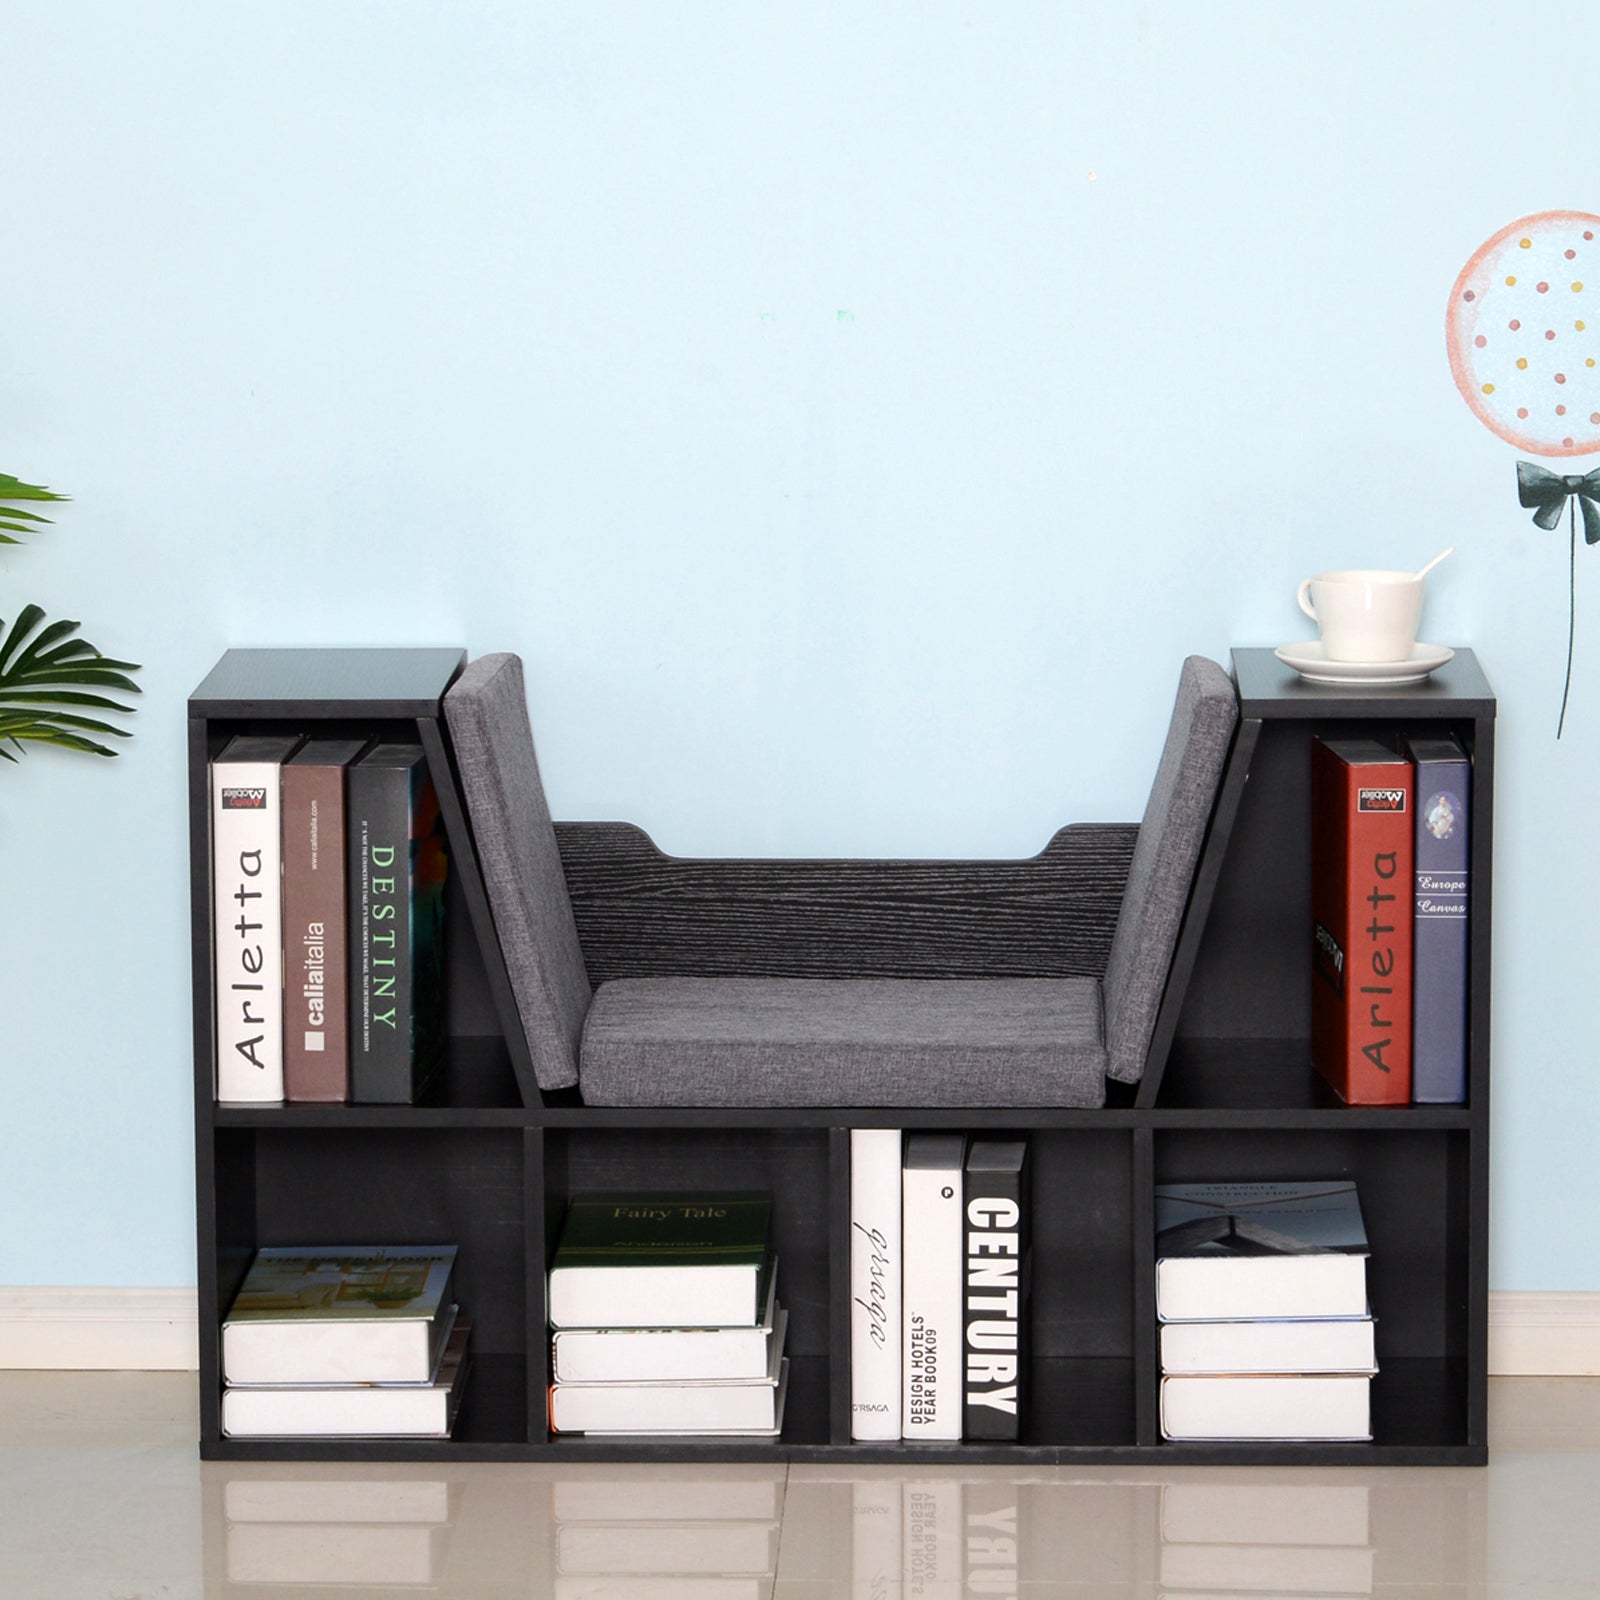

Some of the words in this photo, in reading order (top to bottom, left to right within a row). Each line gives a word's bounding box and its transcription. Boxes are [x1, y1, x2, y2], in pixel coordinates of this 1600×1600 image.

[1417, 899, 1467, 914] Canvas
[1418, 876, 1467, 893] Europe
[231, 849, 265, 1070] Arletta
[303, 922, 325, 1027] caliaitalia
[372, 845, 396, 1029] DESTINY
[1360, 851, 1398, 1074] Arletta
[613, 1207, 673, 1221] Fairy
[680, 1207, 728, 1218] Tale
[966, 1197, 1020, 1416] CENTURY
[911, 1373, 923, 1425] DESIGN
[923, 1389, 936, 1425] YEAR
